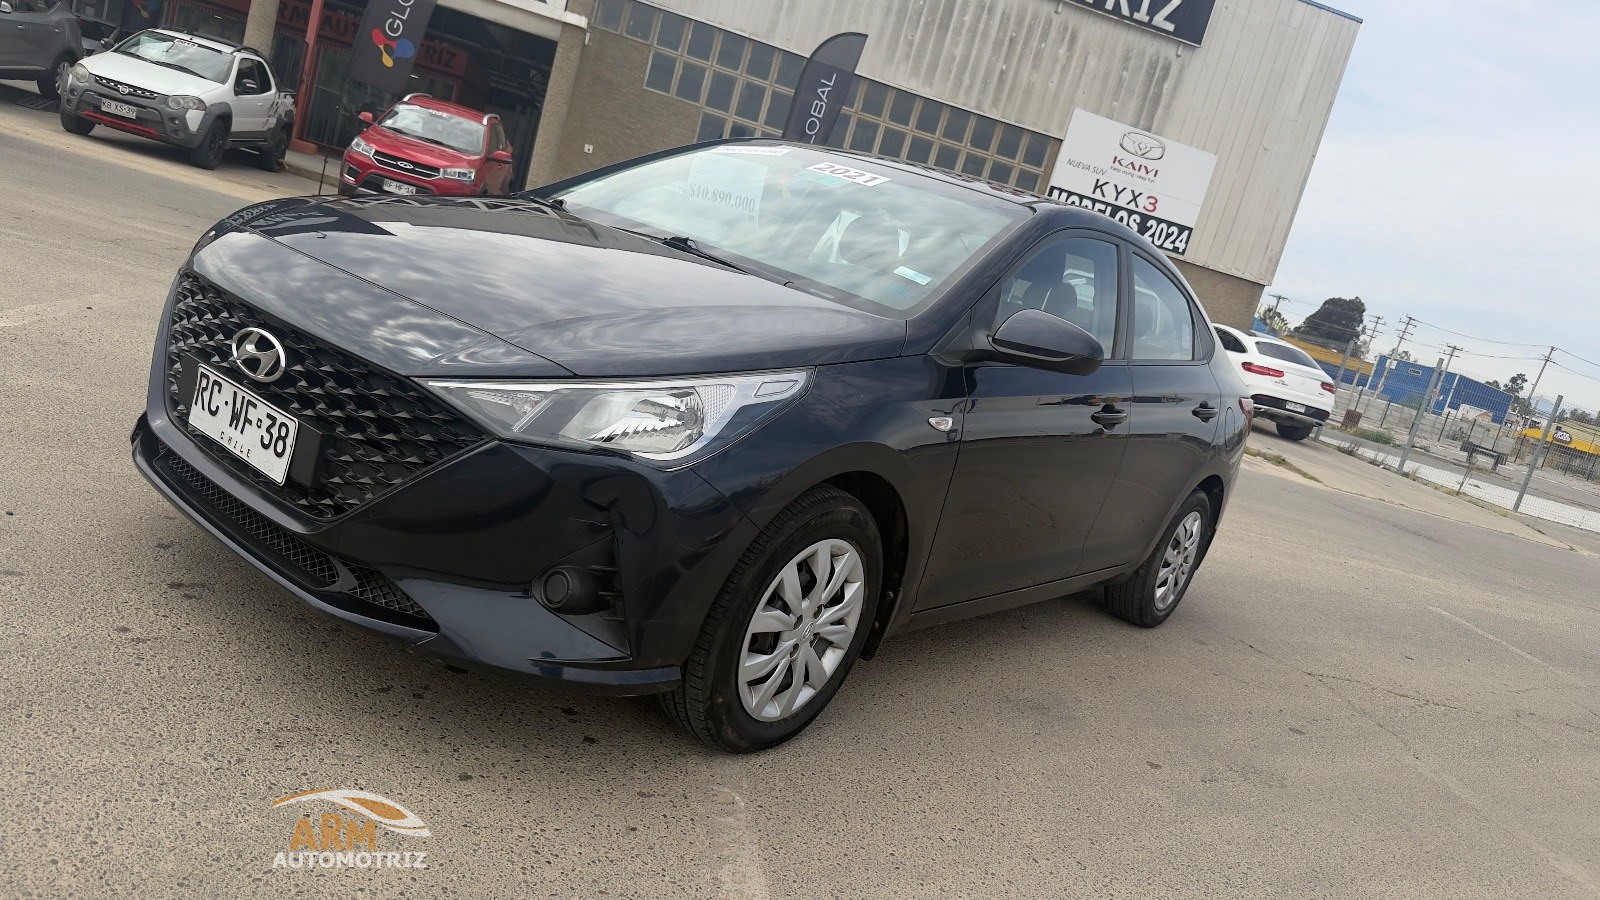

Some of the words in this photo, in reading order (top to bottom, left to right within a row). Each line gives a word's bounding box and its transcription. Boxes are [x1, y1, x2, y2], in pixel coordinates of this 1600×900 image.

[385, 0, 414, 37] GL
[812, 163, 881, 184] 2021
[1066, 158, 1091, 172] NUEVA
[1091, 166, 1108, 176] SUV
[688, 183, 756, 213] $10.890.000
[1092, 178, 1158, 213] KYX3
[1143, 219, 1190, 253] 2024
[220, 430, 252, 458] CHILE
